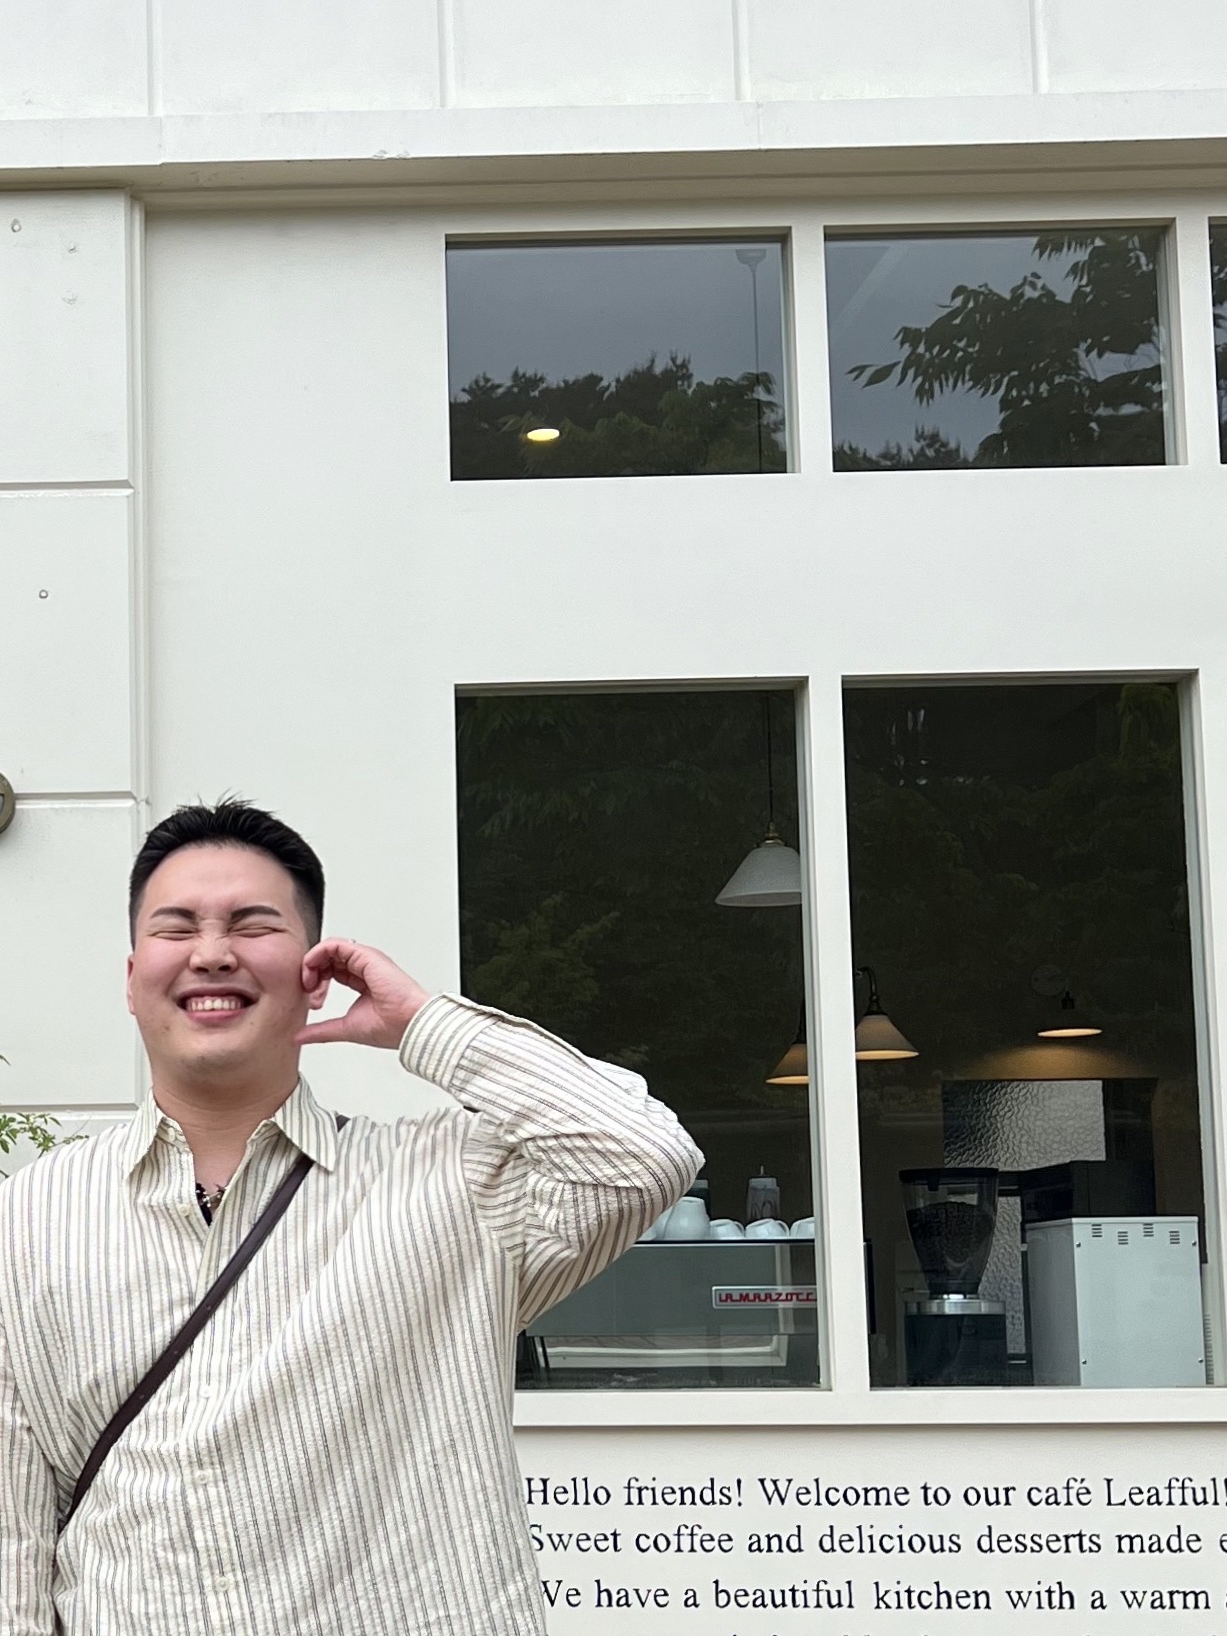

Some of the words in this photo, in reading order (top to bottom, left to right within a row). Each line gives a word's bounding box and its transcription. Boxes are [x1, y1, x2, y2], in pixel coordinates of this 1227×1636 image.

[738, 1291, 817, 1303] MARZOCC
[524, 1477, 611, 1507] Hello
[623, 1477, 742, 1507] friends!
[757, 1478, 910, 1507] Welcome
[920, 1482, 952, 1507] to
[962, 1486, 1016, 1507] our
[1026, 1477, 1092, 1507] café
[529, 1524, 621, 1553] Sweet
[635, 1523, 734, 1553] coffee
[747, 1524, 805, 1554] and
[818, 1524, 962, 1554] delicious
[976, 1524, 1102, 1554] desserts
[1115, 1525, 1202, 1554] made
[594, 1580, 670, 1608] have
[683, 1588, 700, 1608] a
[712, 1578, 855, 1609] beautiful
[873, 1580, 992, 1610] kitchen
[1005, 1580, 1075, 1610] with
[1090, 1590, 1108, 1610] a
[1119, 1589, 1211, 1610] warm
